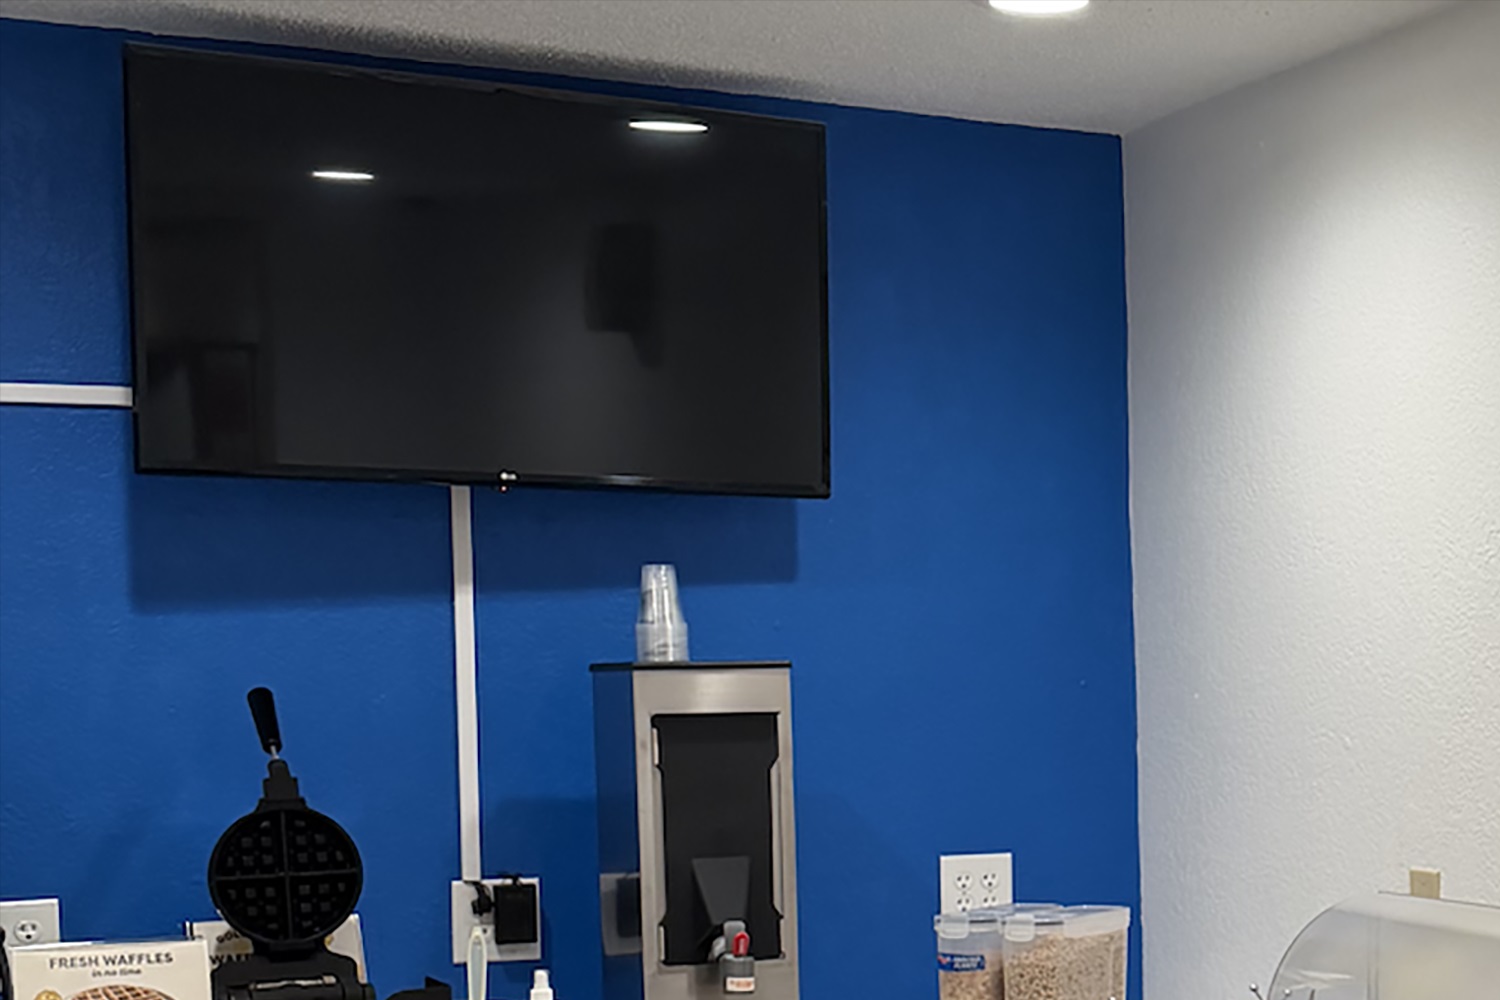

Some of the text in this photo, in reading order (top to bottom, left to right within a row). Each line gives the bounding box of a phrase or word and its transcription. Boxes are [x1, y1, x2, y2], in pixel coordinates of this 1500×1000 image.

[49, 952, 174, 969] FRESH WAFFLES
[92, 969, 102, 977] in
[119, 968, 142, 976] time
